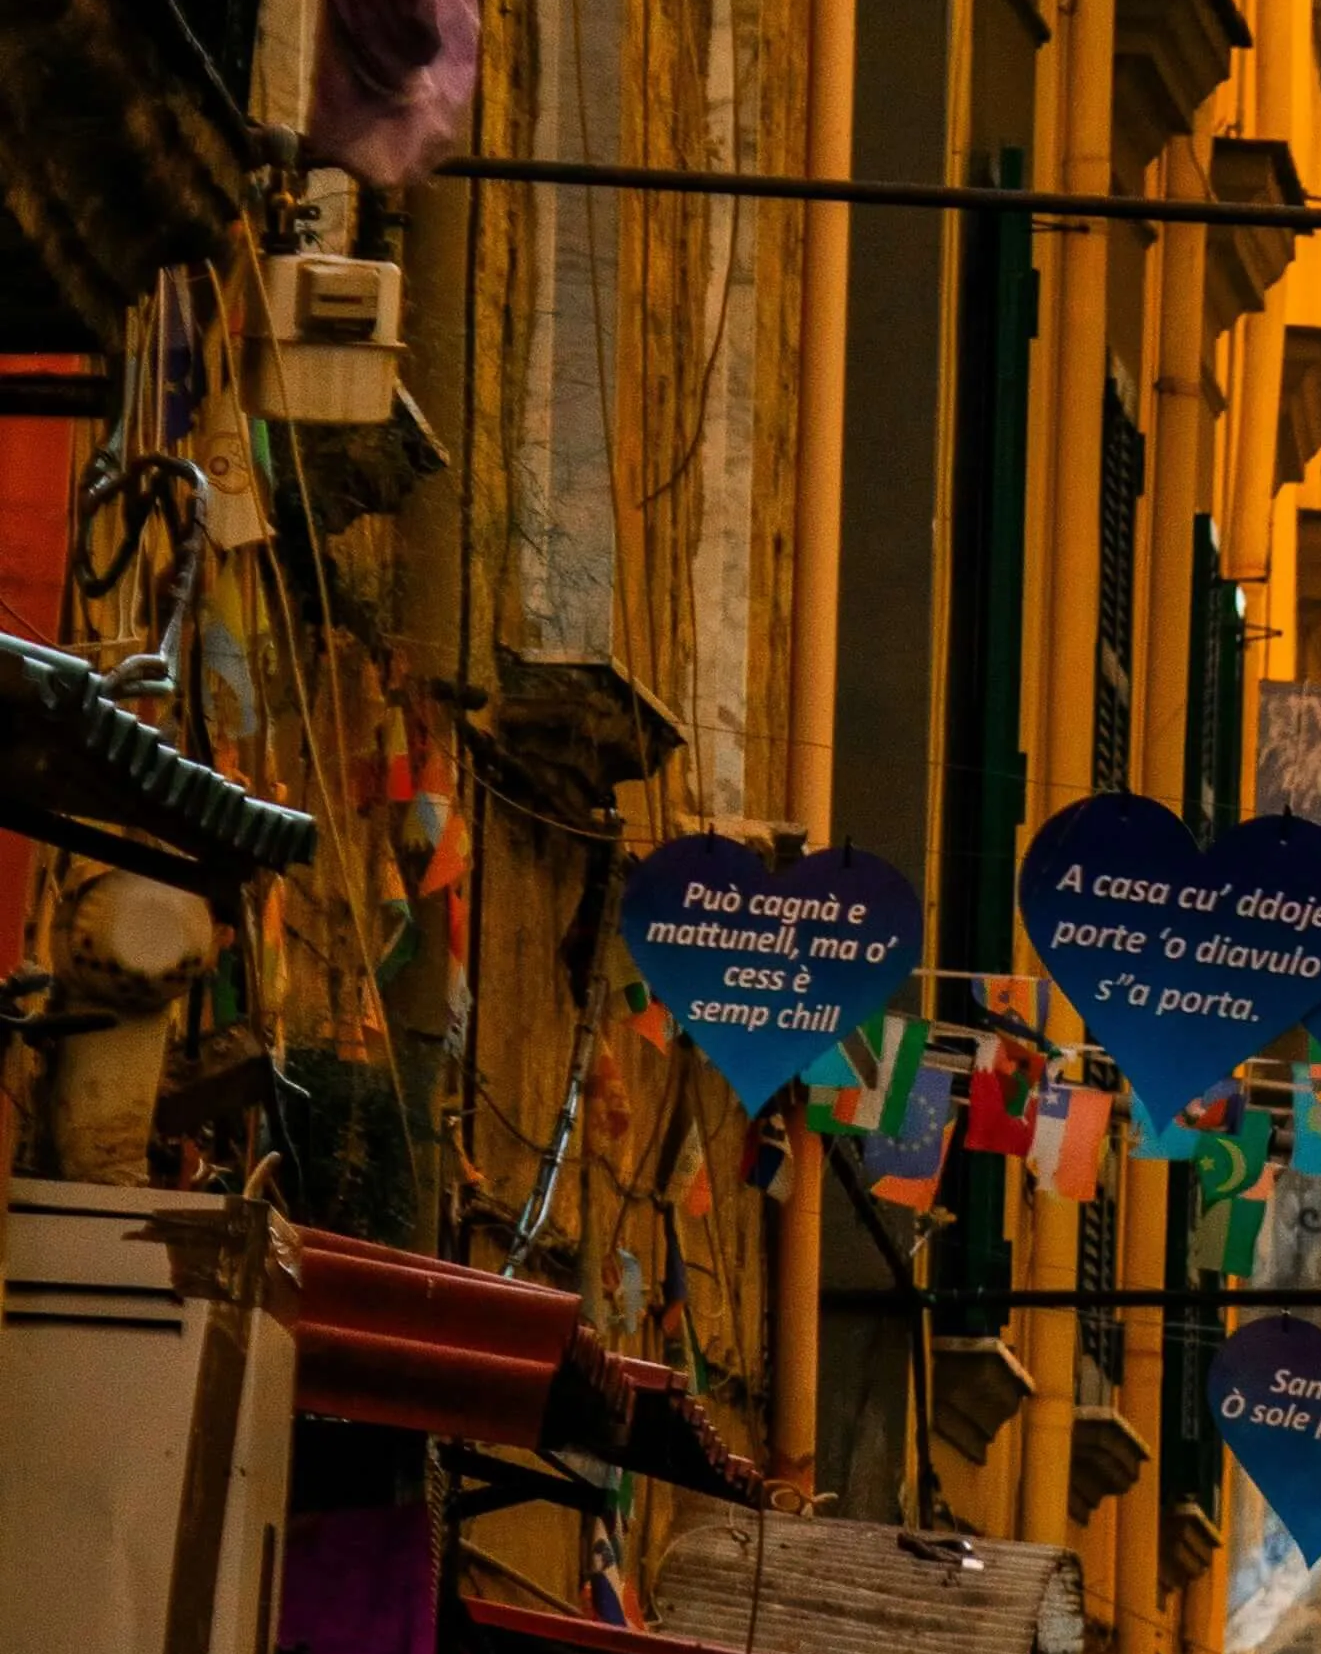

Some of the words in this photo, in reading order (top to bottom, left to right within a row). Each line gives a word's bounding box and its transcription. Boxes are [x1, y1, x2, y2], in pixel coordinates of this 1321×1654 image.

[682, 881, 742, 913] Può
[748, 892, 838, 925] cagnà
[847, 903, 867, 925] e
[1055, 863, 1083, 894] A
[1092, 874, 1171, 905] casa
[645, 921, 801, 959] mattunell,
[808, 936, 859, 961] ma
[1050, 920, 1148, 954] porte
[1194, 933, 1321, 979] diavulo
[723, 965, 786, 992] cess
[791, 965, 812, 994] è
[687, 999, 771, 1032] semp
[776, 1004, 841, 1033] chill
[1155, 987, 1260, 1023] porta.
[1220, 1386, 1247, 1419] Ò
[1250, 1402, 1311, 1431] sole
